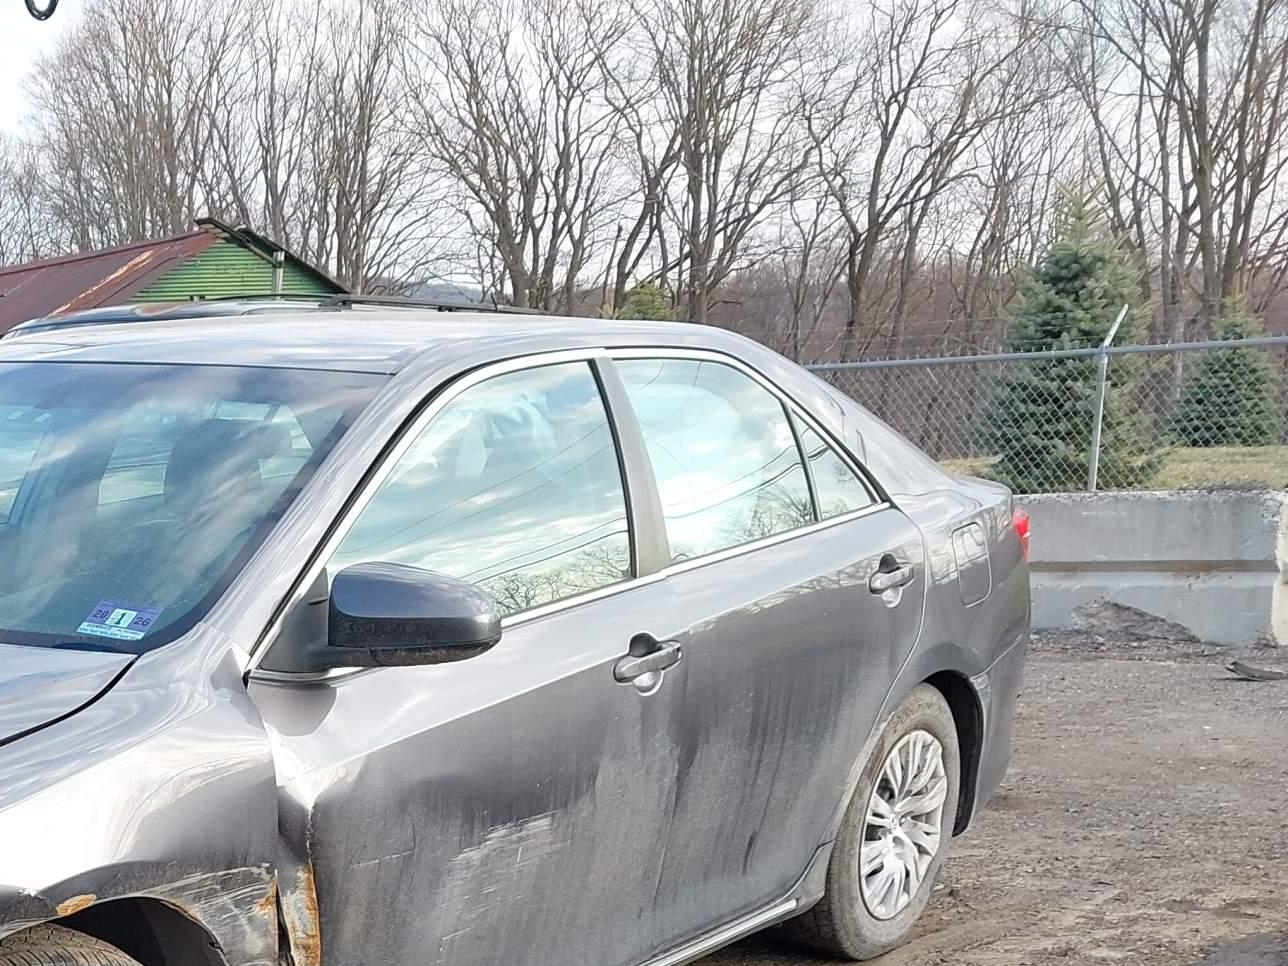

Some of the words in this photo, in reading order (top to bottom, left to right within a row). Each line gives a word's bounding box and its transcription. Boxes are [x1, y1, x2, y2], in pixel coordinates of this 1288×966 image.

[92, 609, 109, 619] 20
[114, 612, 128, 625] 1
[133, 616, 152, 627] 26
